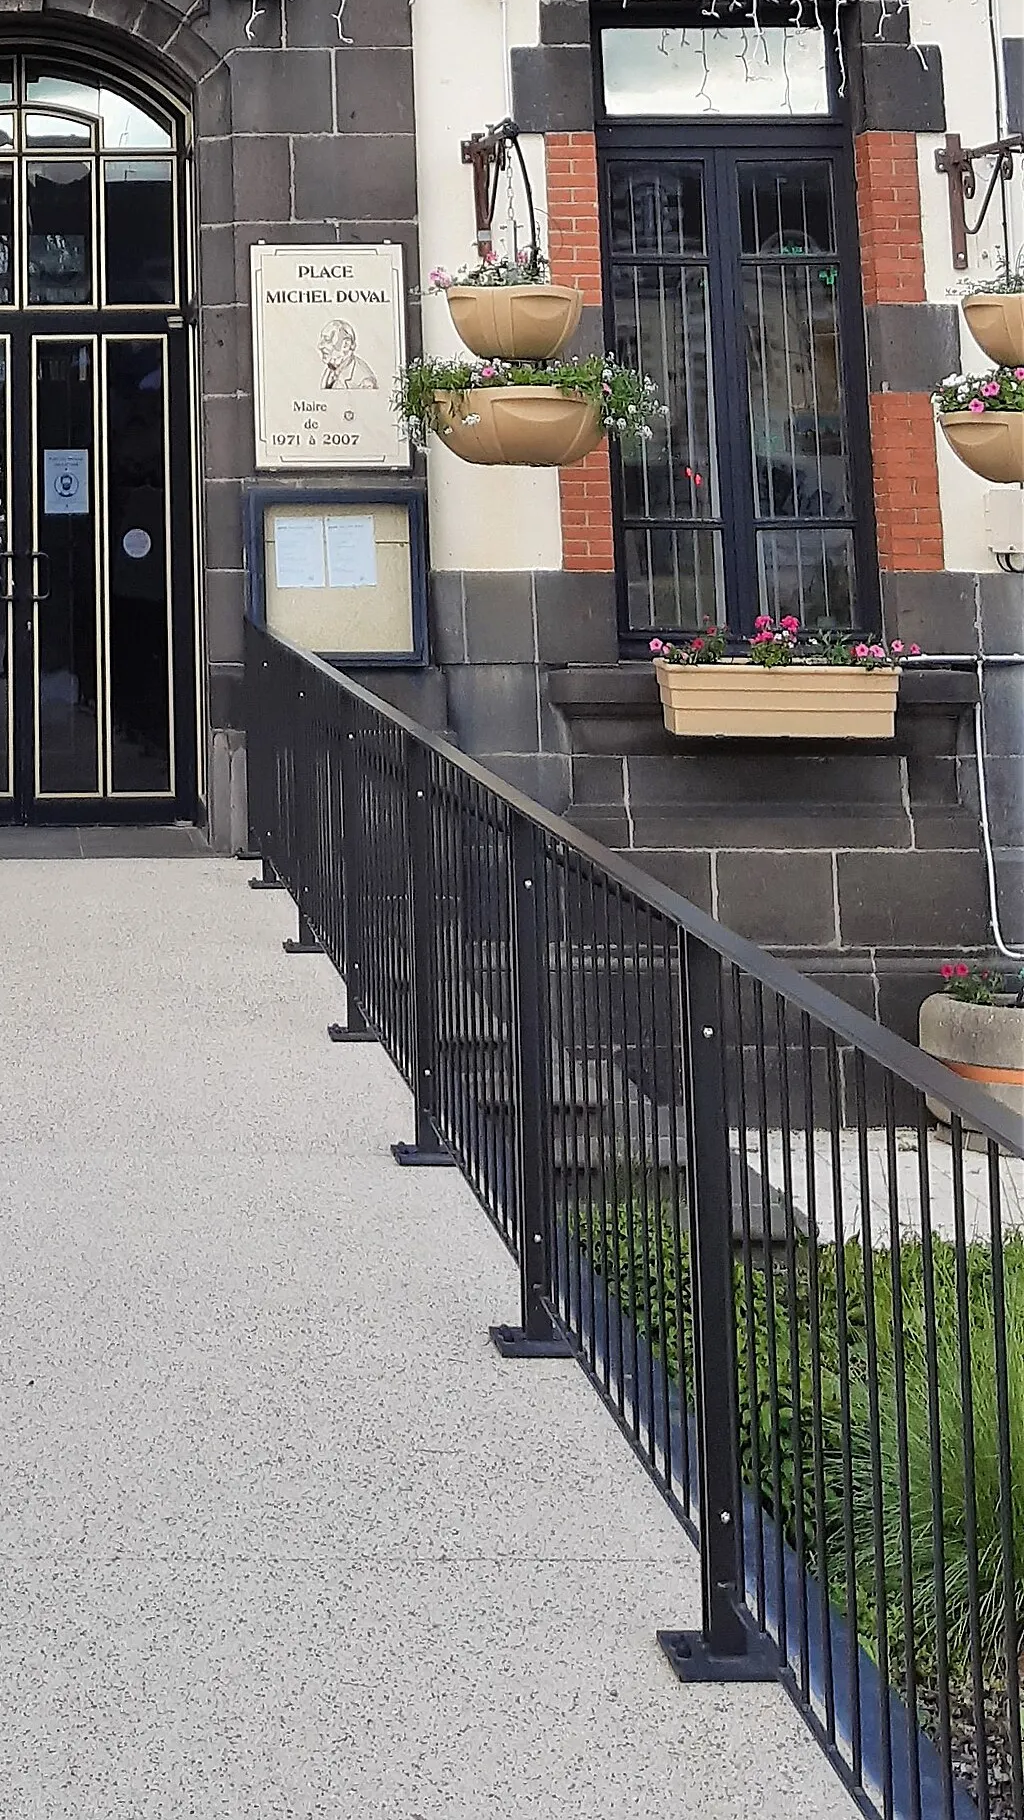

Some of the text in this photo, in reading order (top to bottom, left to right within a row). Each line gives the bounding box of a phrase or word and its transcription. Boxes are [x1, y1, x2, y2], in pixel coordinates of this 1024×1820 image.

[298, 265, 354, 279] PLACE
[266, 290, 391, 303] MICHEL DUVAL
[293, 401, 328, 412] Maire
[304, 418, 319, 430] de
[272, 434, 360, 445] 1971 à 2007
